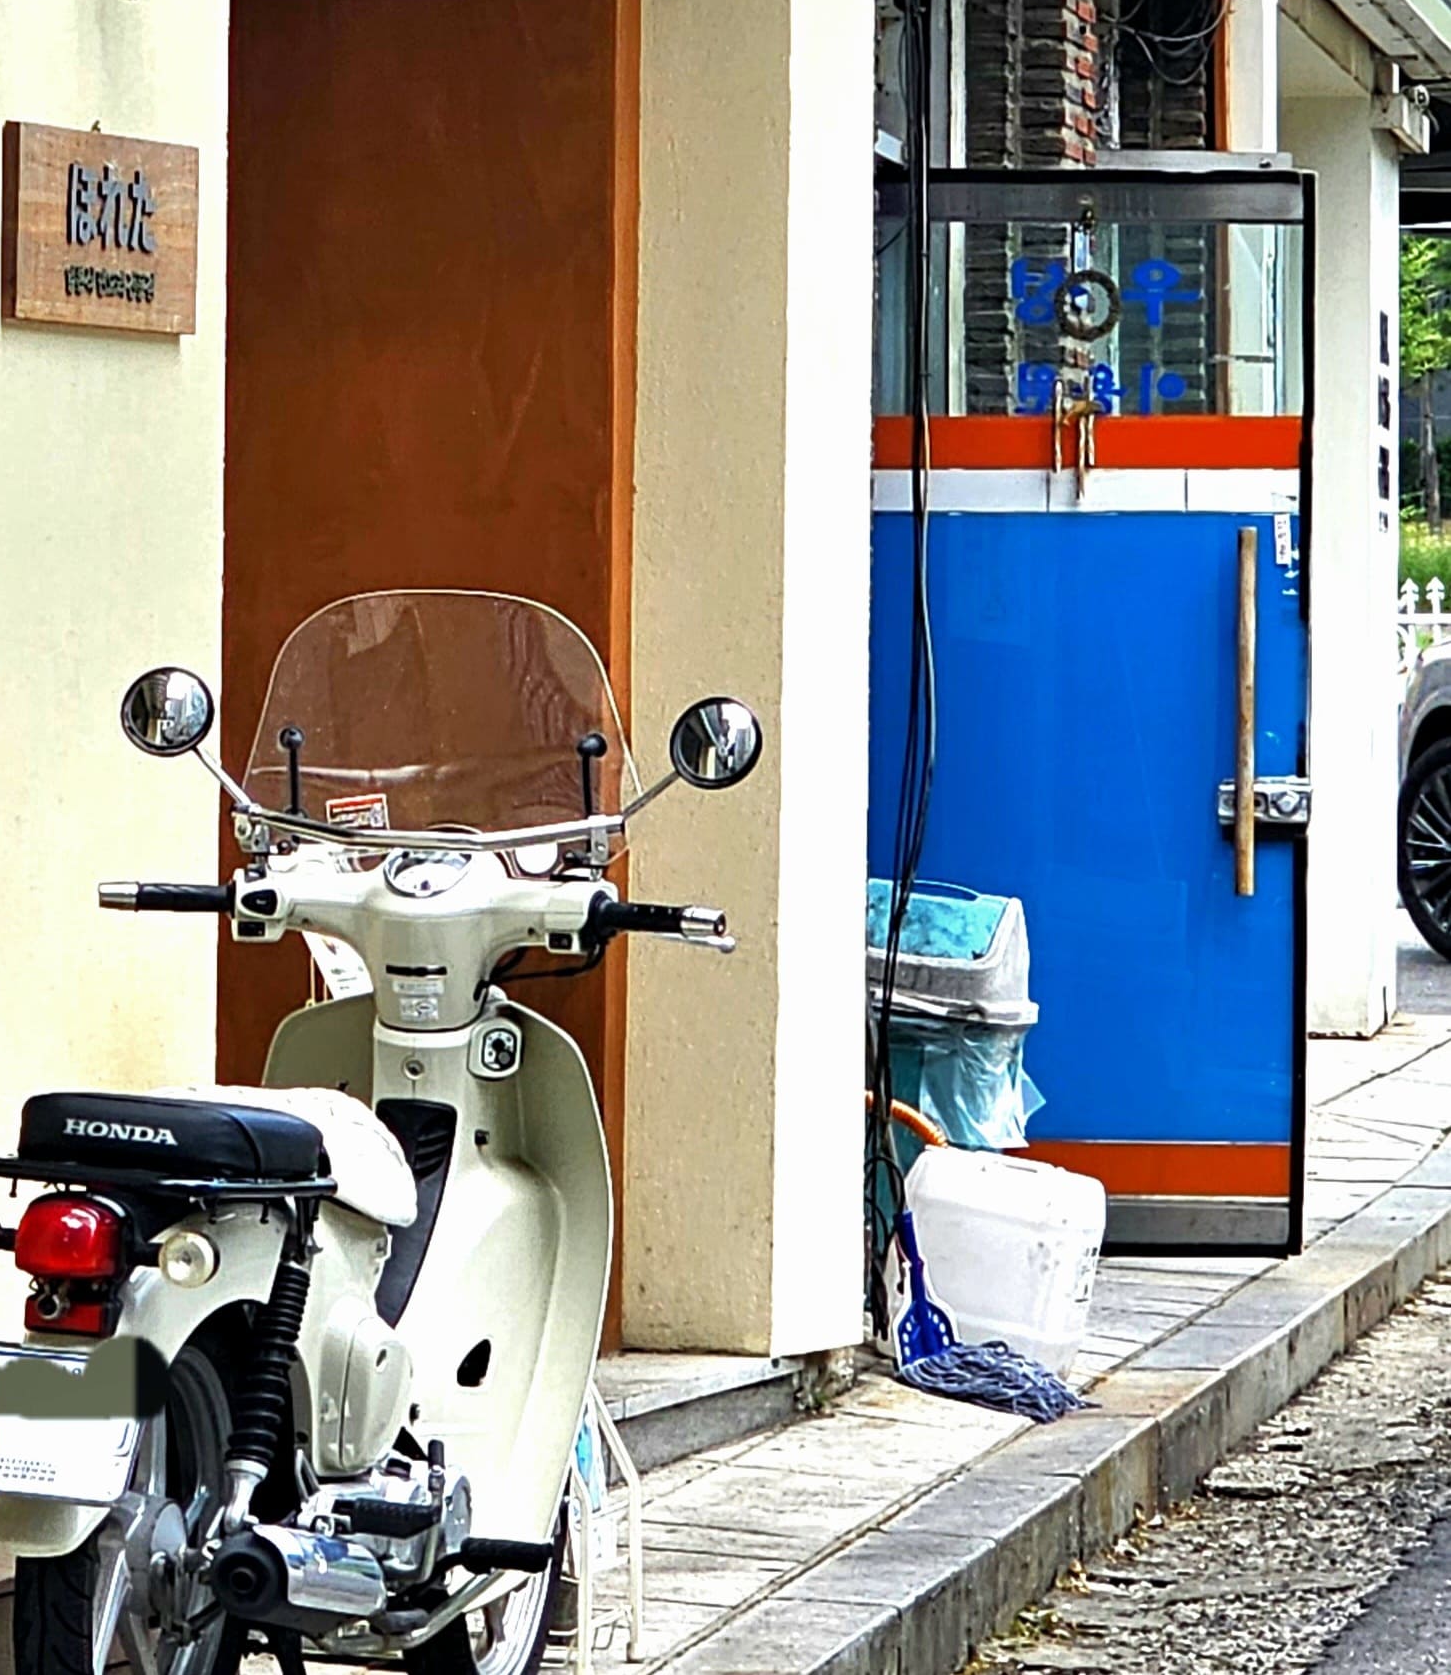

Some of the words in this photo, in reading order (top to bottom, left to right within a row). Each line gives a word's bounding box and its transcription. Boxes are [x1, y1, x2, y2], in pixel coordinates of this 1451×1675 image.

[66, 161, 157, 254] ほれた
[63, 1118, 178, 1146] HONDA
